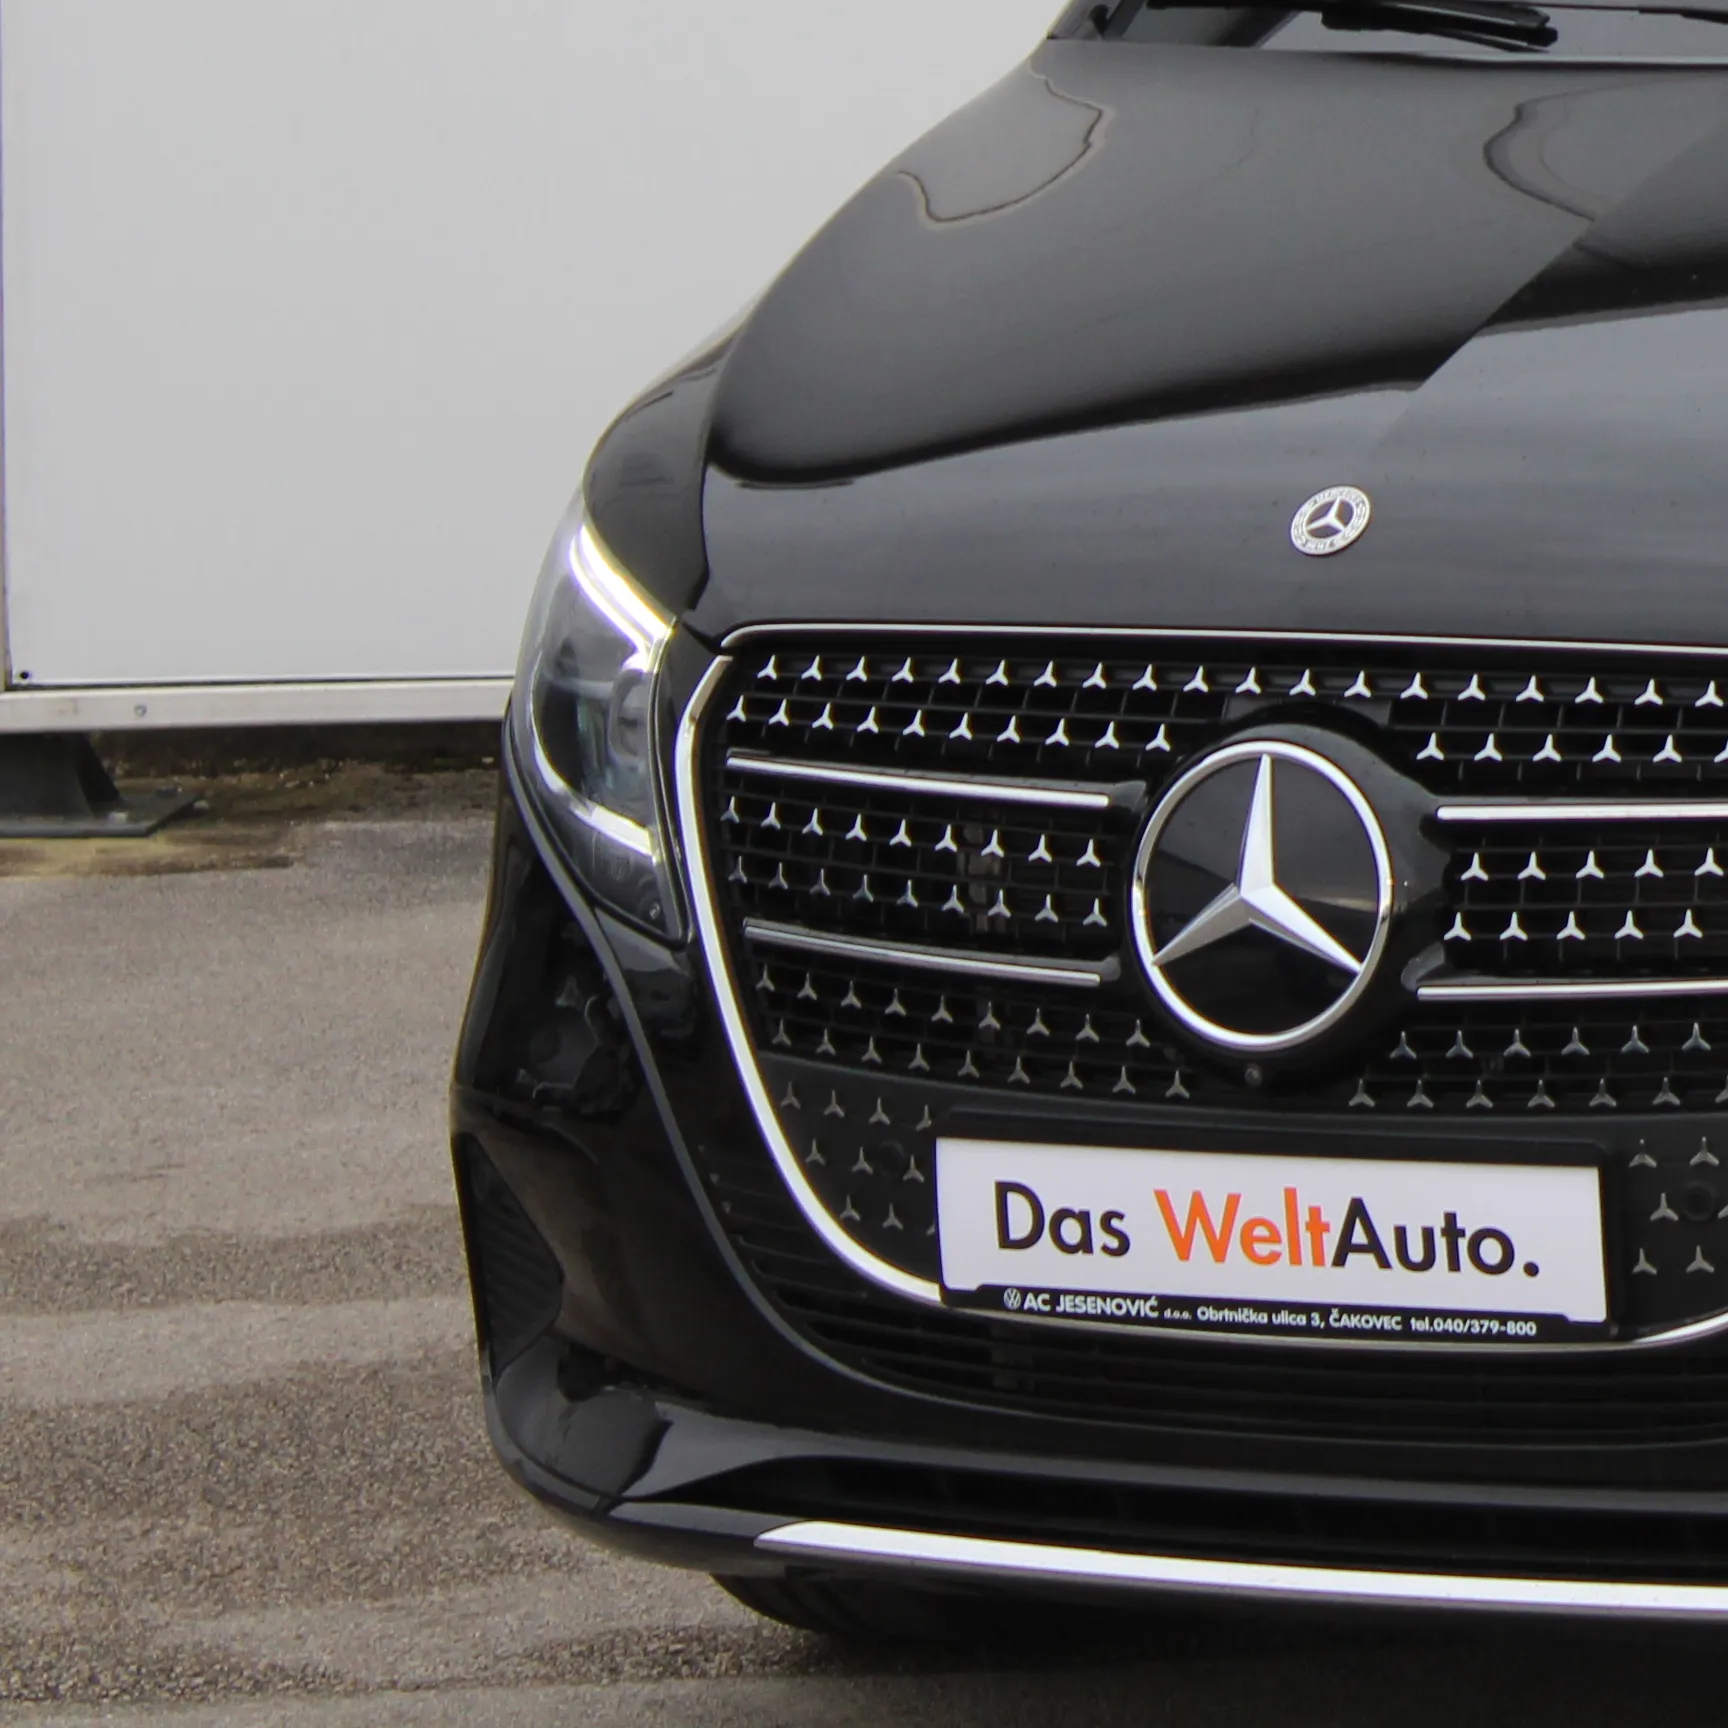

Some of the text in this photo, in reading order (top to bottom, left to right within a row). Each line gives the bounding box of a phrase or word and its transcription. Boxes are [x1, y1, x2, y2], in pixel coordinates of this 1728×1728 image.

[994, 1180, 1540, 1278] Das WeltAuto.
[1023, 1292, 1051, 1312] AC
[1055, 1294, 1159, 1318] JESENOVIĆ
[1196, 1305, 1268, 1325] Obrtnička
[1271, 1310, 1307, 1327] ulica
[1310, 1312, 1326, 1329] 3,
[1328, 1308, 1403, 1331] ČAKOVEC
[1409, 1317, 1538, 1337] tel.040/379-800
